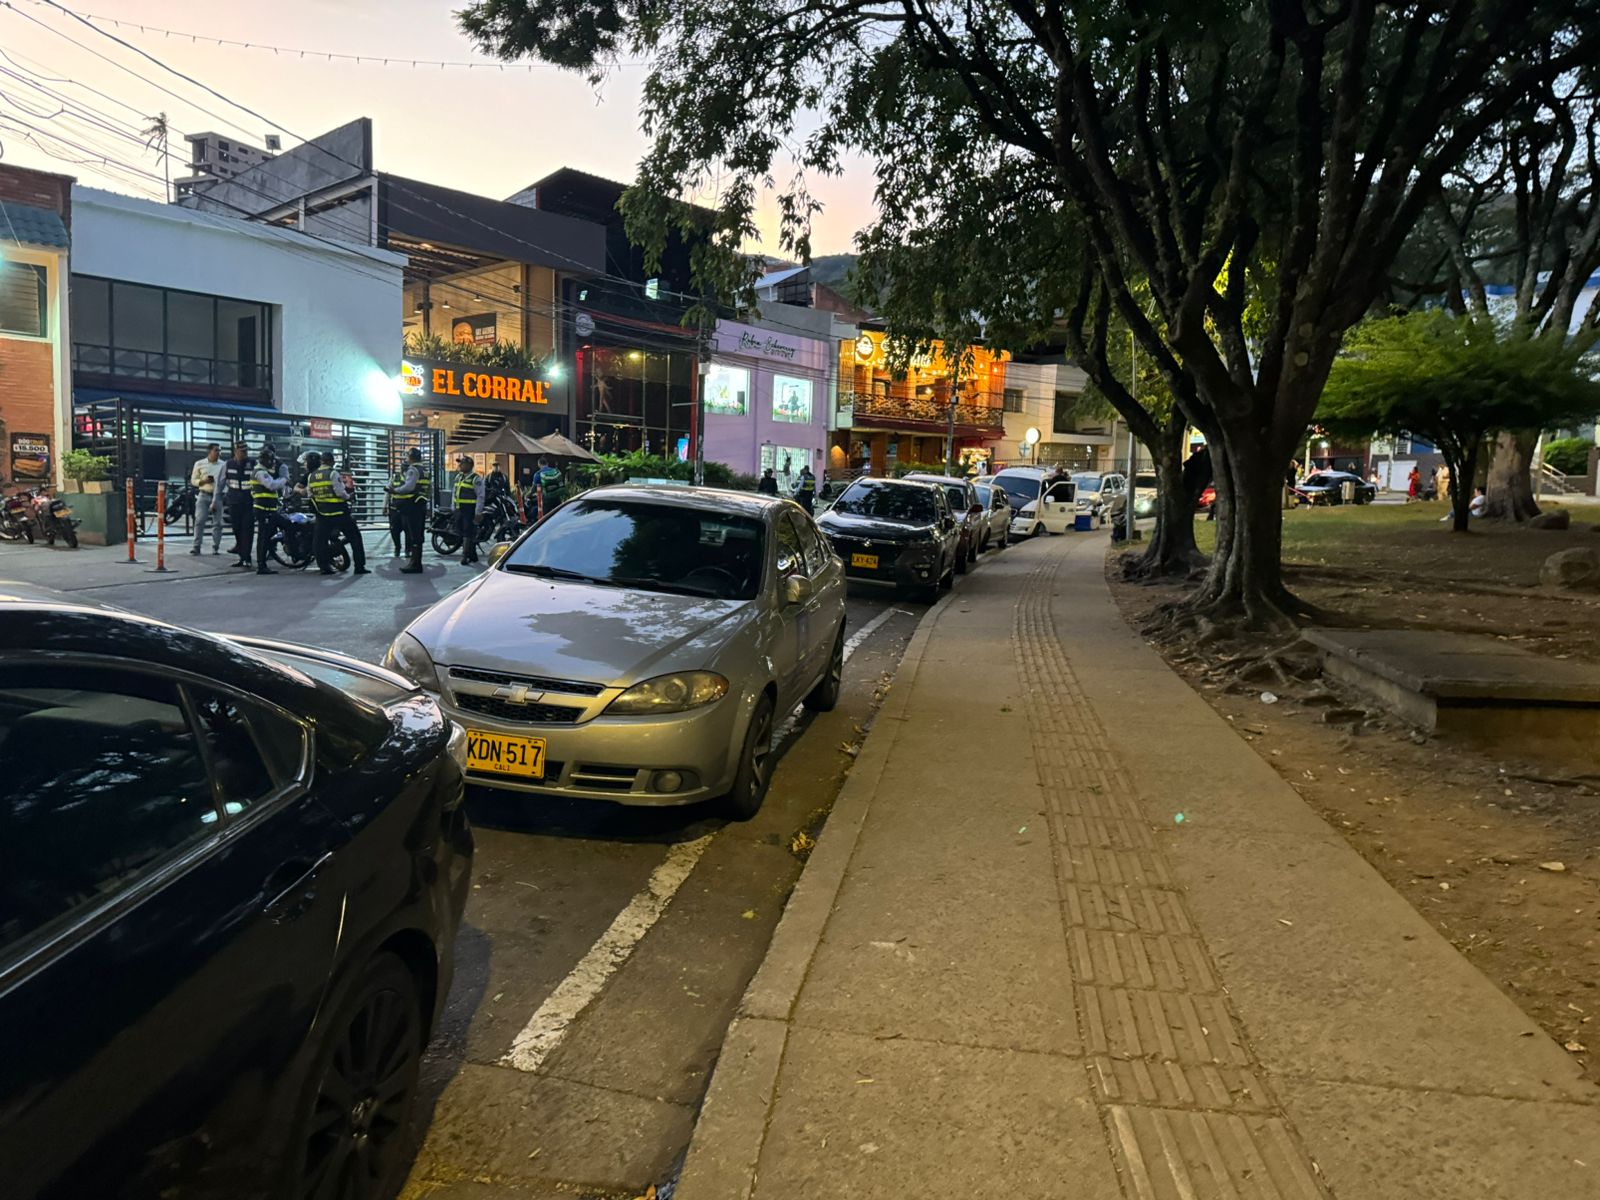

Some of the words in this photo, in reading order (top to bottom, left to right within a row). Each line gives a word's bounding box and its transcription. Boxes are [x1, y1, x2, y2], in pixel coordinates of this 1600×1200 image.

[432, 368, 460, 395] EL
[462, 372, 549, 404] CORRAL
[467, 737, 502, 762] KDN
[506, 742, 542, 767] 517
